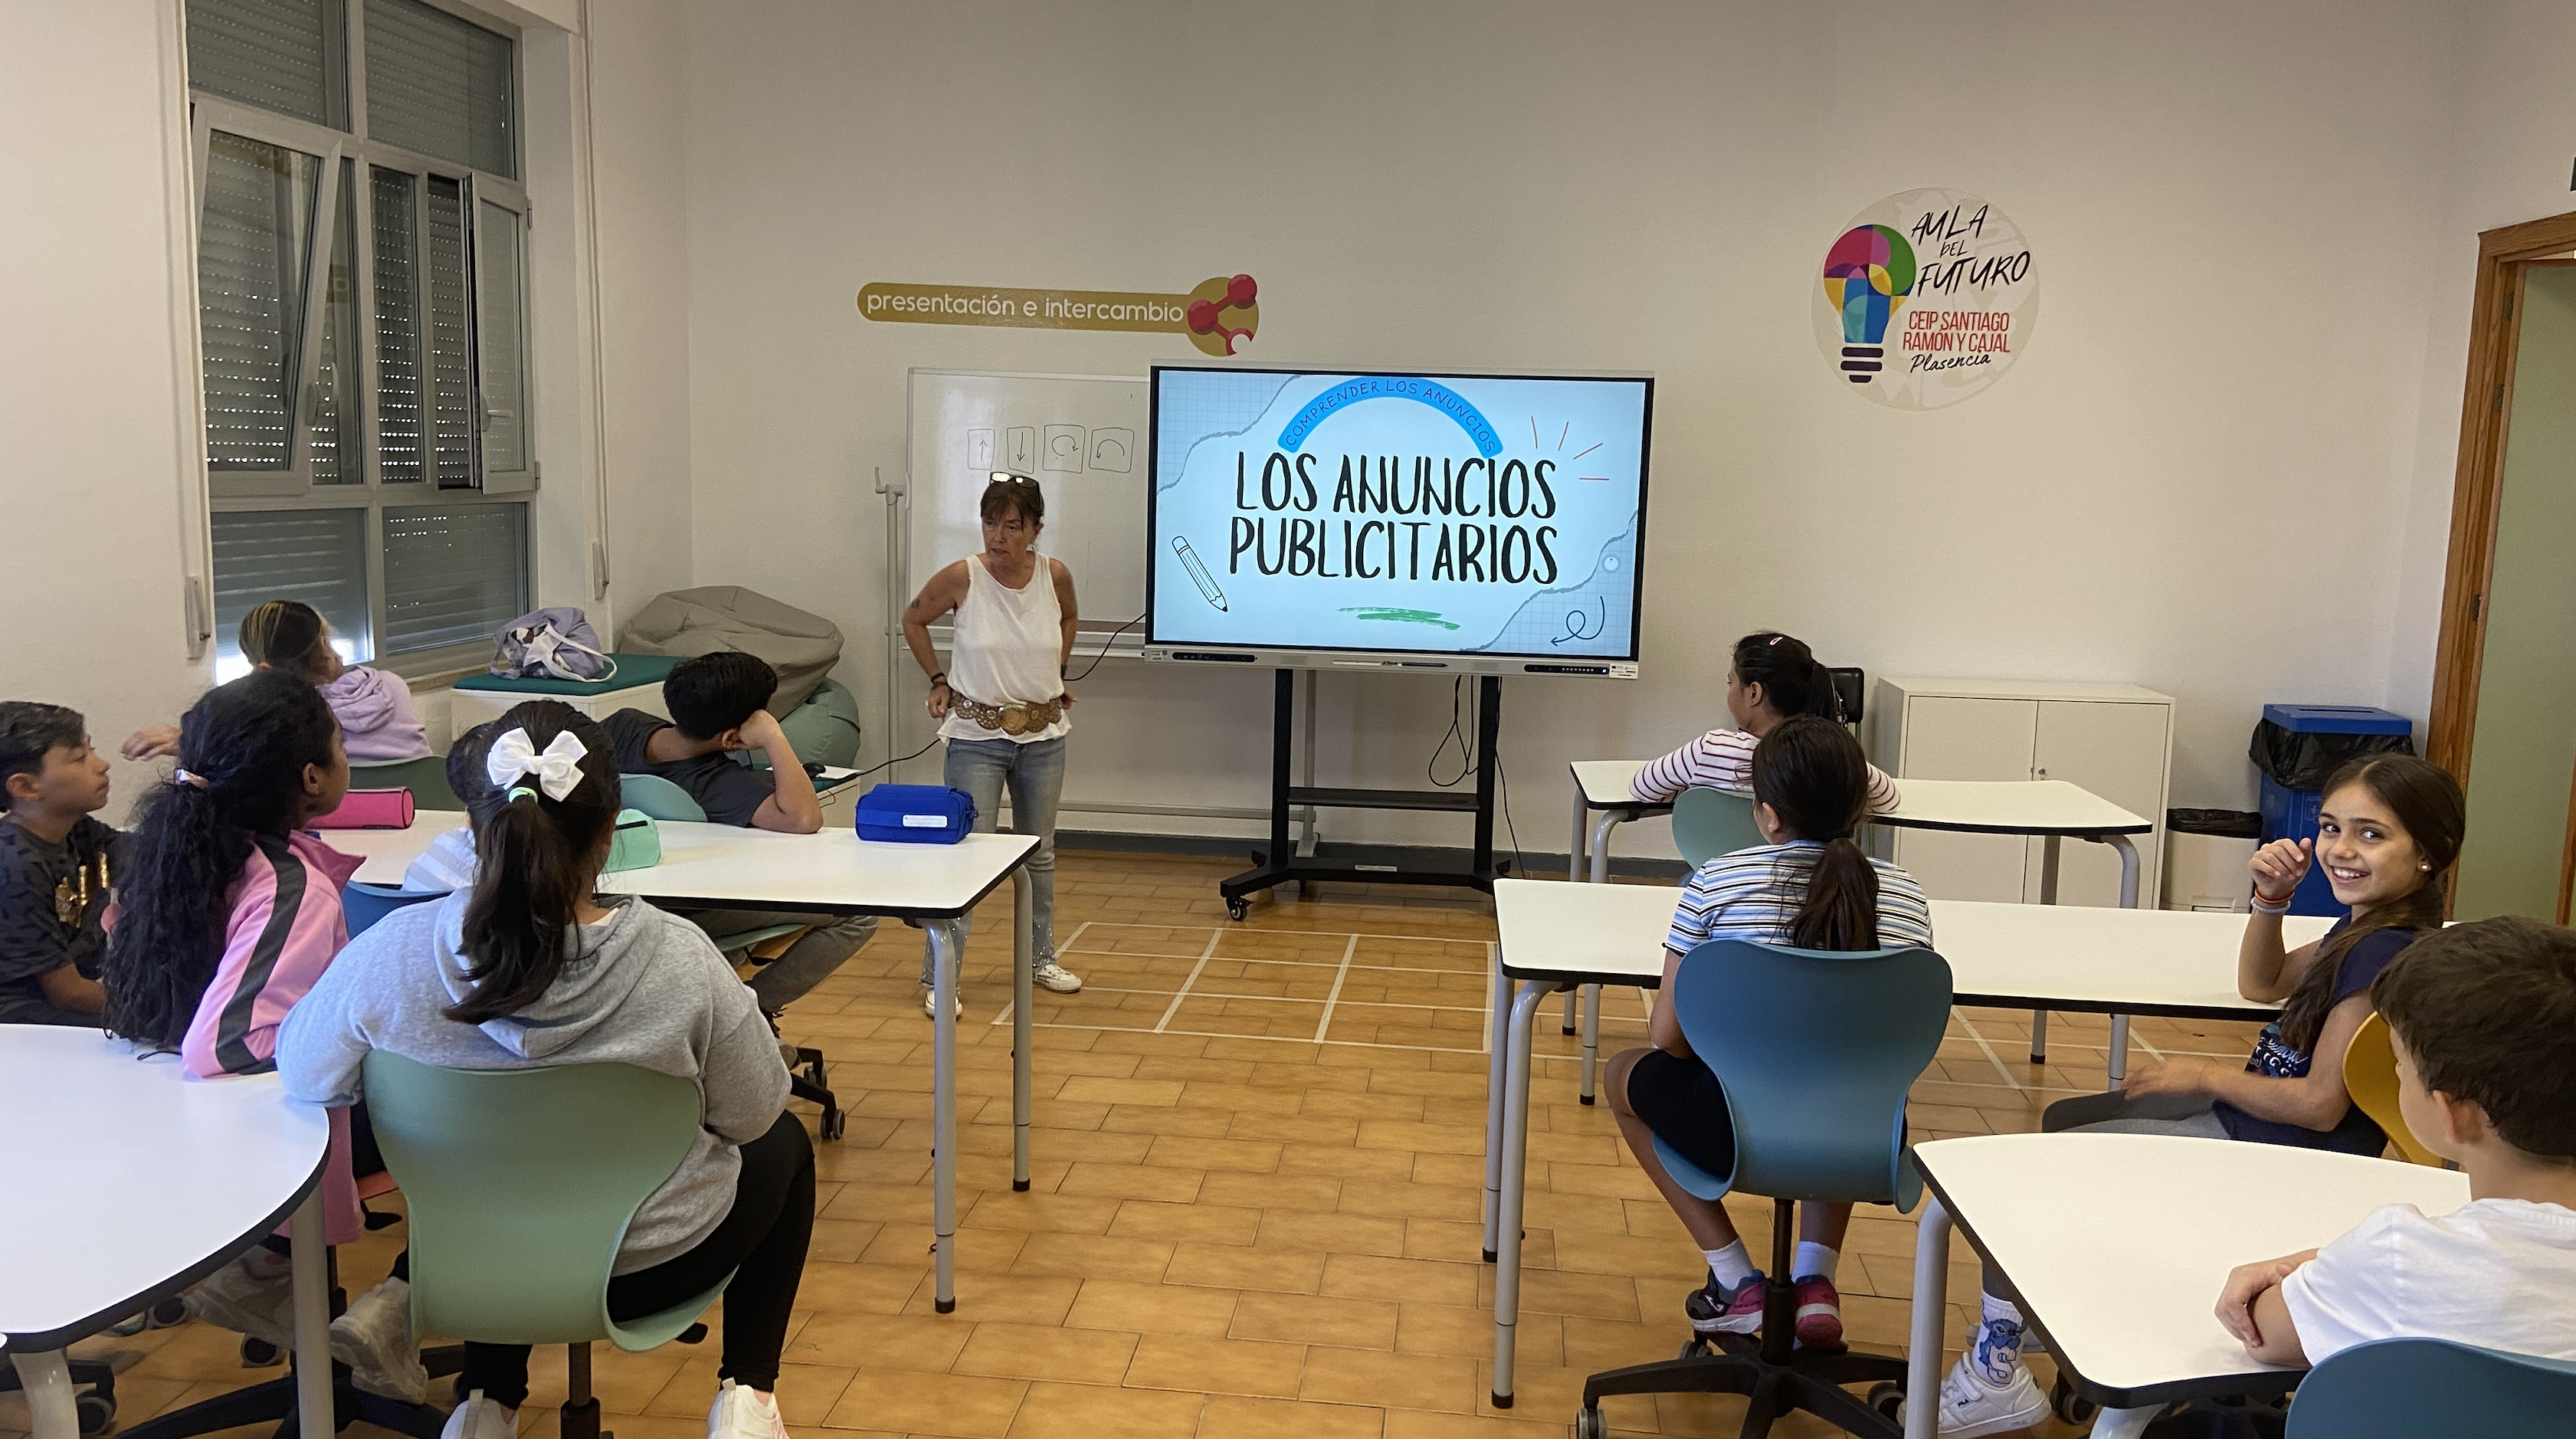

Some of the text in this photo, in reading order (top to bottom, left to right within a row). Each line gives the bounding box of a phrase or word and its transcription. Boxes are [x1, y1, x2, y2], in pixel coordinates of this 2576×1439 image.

[1911, 205, 1988, 245] AULA
[1939, 240, 1968, 258] DEL
[1917, 251, 2030, 297] FUTURO
[867, 293, 1185, 323] presentación e intercambio
[1909, 311, 2009, 332] CEIP SANTIAGO
[1903, 329, 2011, 352] RAMÓN Y CAJAL
[1909, 350, 1991, 373] Plasencia
[1286, 380, 1496, 453] COMPRENDER LOS ANUNCIOS
[1236, 451, 1557, 519] LOS ANUNCIOS
[1230, 516, 1558, 585] PUBLICITARIOS
